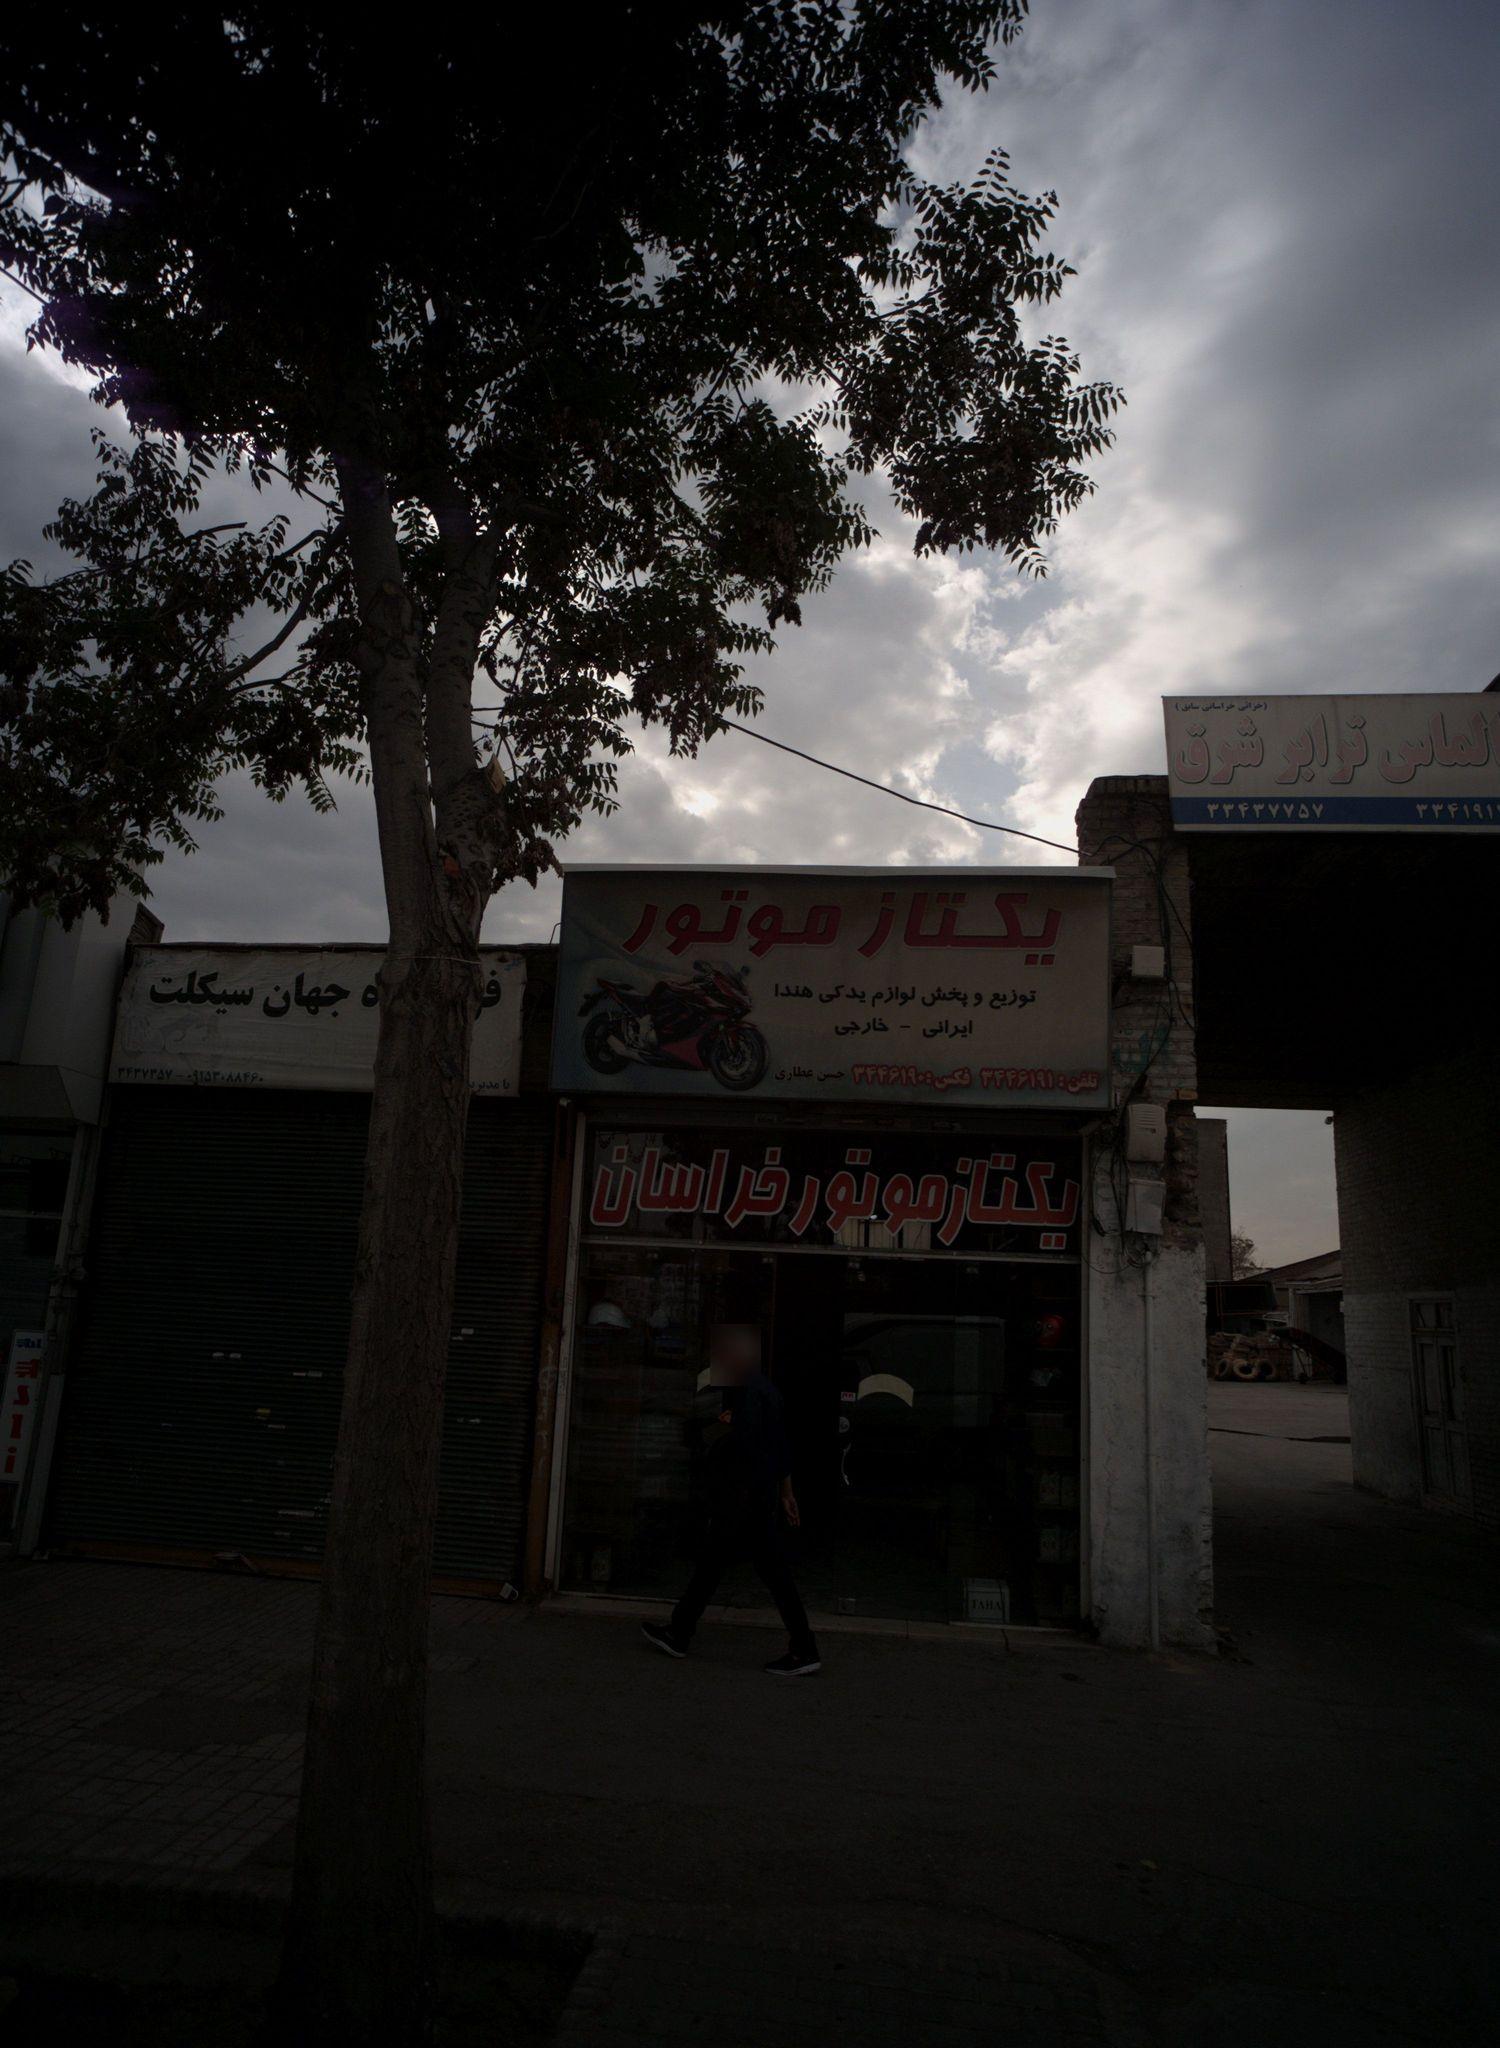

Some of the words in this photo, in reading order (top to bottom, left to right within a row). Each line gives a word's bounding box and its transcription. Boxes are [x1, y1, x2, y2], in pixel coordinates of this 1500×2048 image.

[1173, 715, 1264, 785] شرق
[1207, 802, 1324, 819] ۳۳۴۳۷۷۵۷
[1416, 802, 1500, 820] ۳۳۴۱۹۱
[622, 889, 843, 958] موتور
[858, 891, 1063, 966] یکتاز
[150, 969, 255, 1015] سیکلت
[263, 972, 351, 1019] جهان
[774, 983, 814, 999] هندا
[818, 985, 866, 1004] یدکی
[871, 986, 916, 1008] لوازم
[921, 988, 969, 1008] پخش
[973, 994, 982, 1004] و
[988, 989, 1036, 1009] توزیع
[834, 1017, 889, 1036] خارجی
[922, 1019, 974, 1039] ایرانی
[774, 1066, 814, 1081] عطاری
[816, 1069, 846, 1082] حسن
[589, 1145, 792, 1229] خراسان
[788, 1147, 949, 1237] موتور
[936, 1153, 1081, 1251] یکتاز
